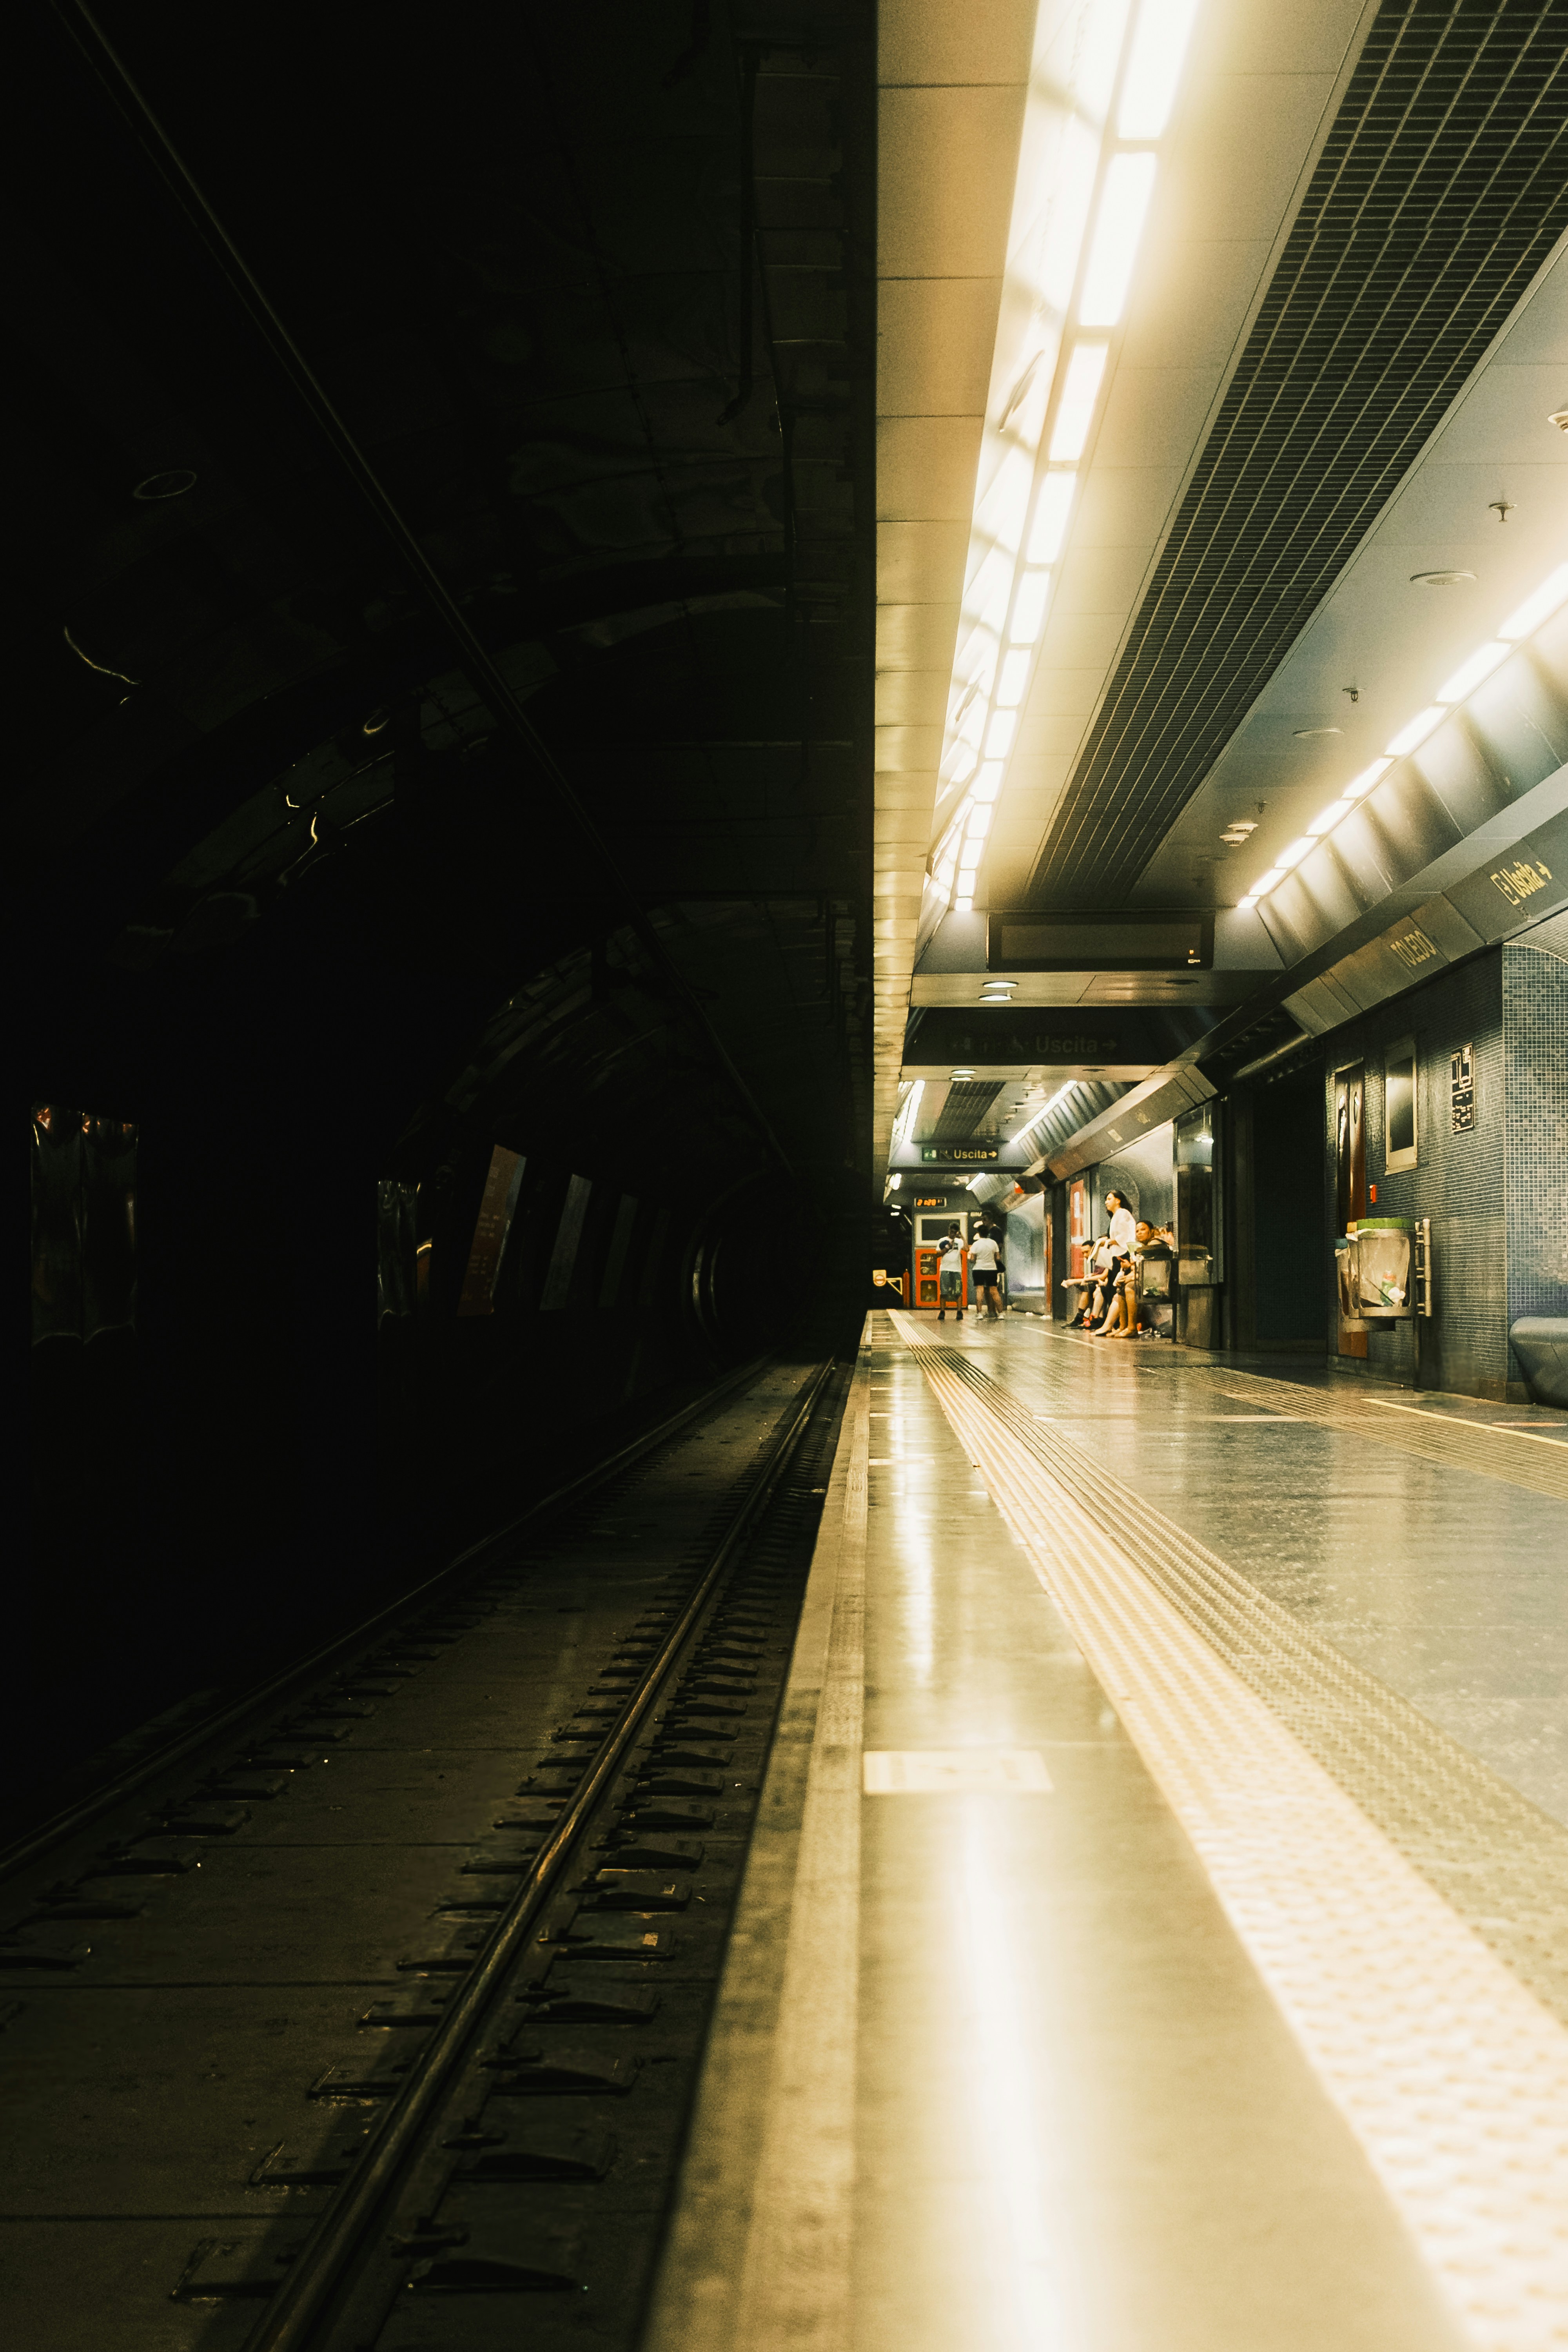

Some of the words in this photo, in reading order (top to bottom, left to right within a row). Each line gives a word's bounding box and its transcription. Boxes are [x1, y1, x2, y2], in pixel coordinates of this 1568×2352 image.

[1500, 862, 1546, 898] Uscita
[1390, 930, 1436, 967] TOLEDO
[1036, 1036, 1097, 1053] Uscita
[954, 1149, 987, 1159] Uscita
